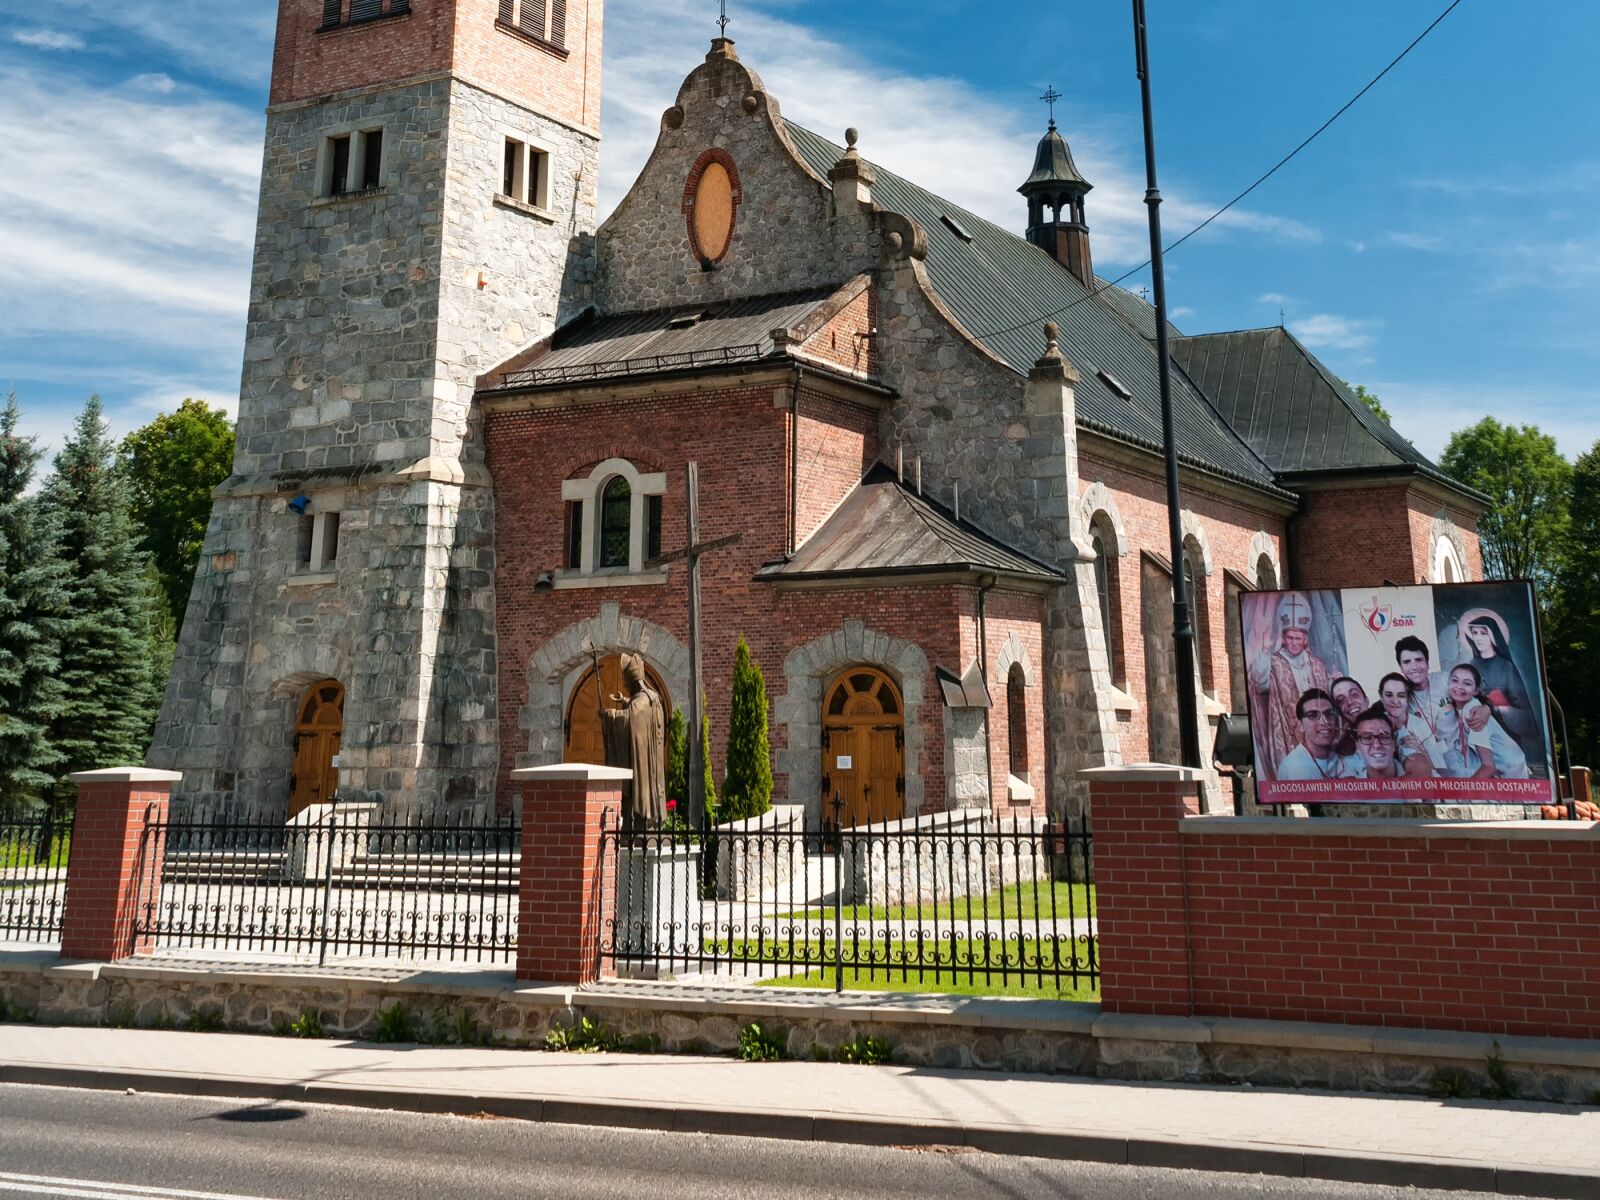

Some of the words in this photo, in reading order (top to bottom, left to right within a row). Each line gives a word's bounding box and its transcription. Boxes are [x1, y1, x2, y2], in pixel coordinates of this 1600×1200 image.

[1334, 782, 1380, 792] MIŁOSIERNI,
[1382, 780, 1421, 791] ALBOWIEM
[1424, 780, 1438, 790] ON
[1440, 780, 1494, 791] MIŁOSIERDZIA
